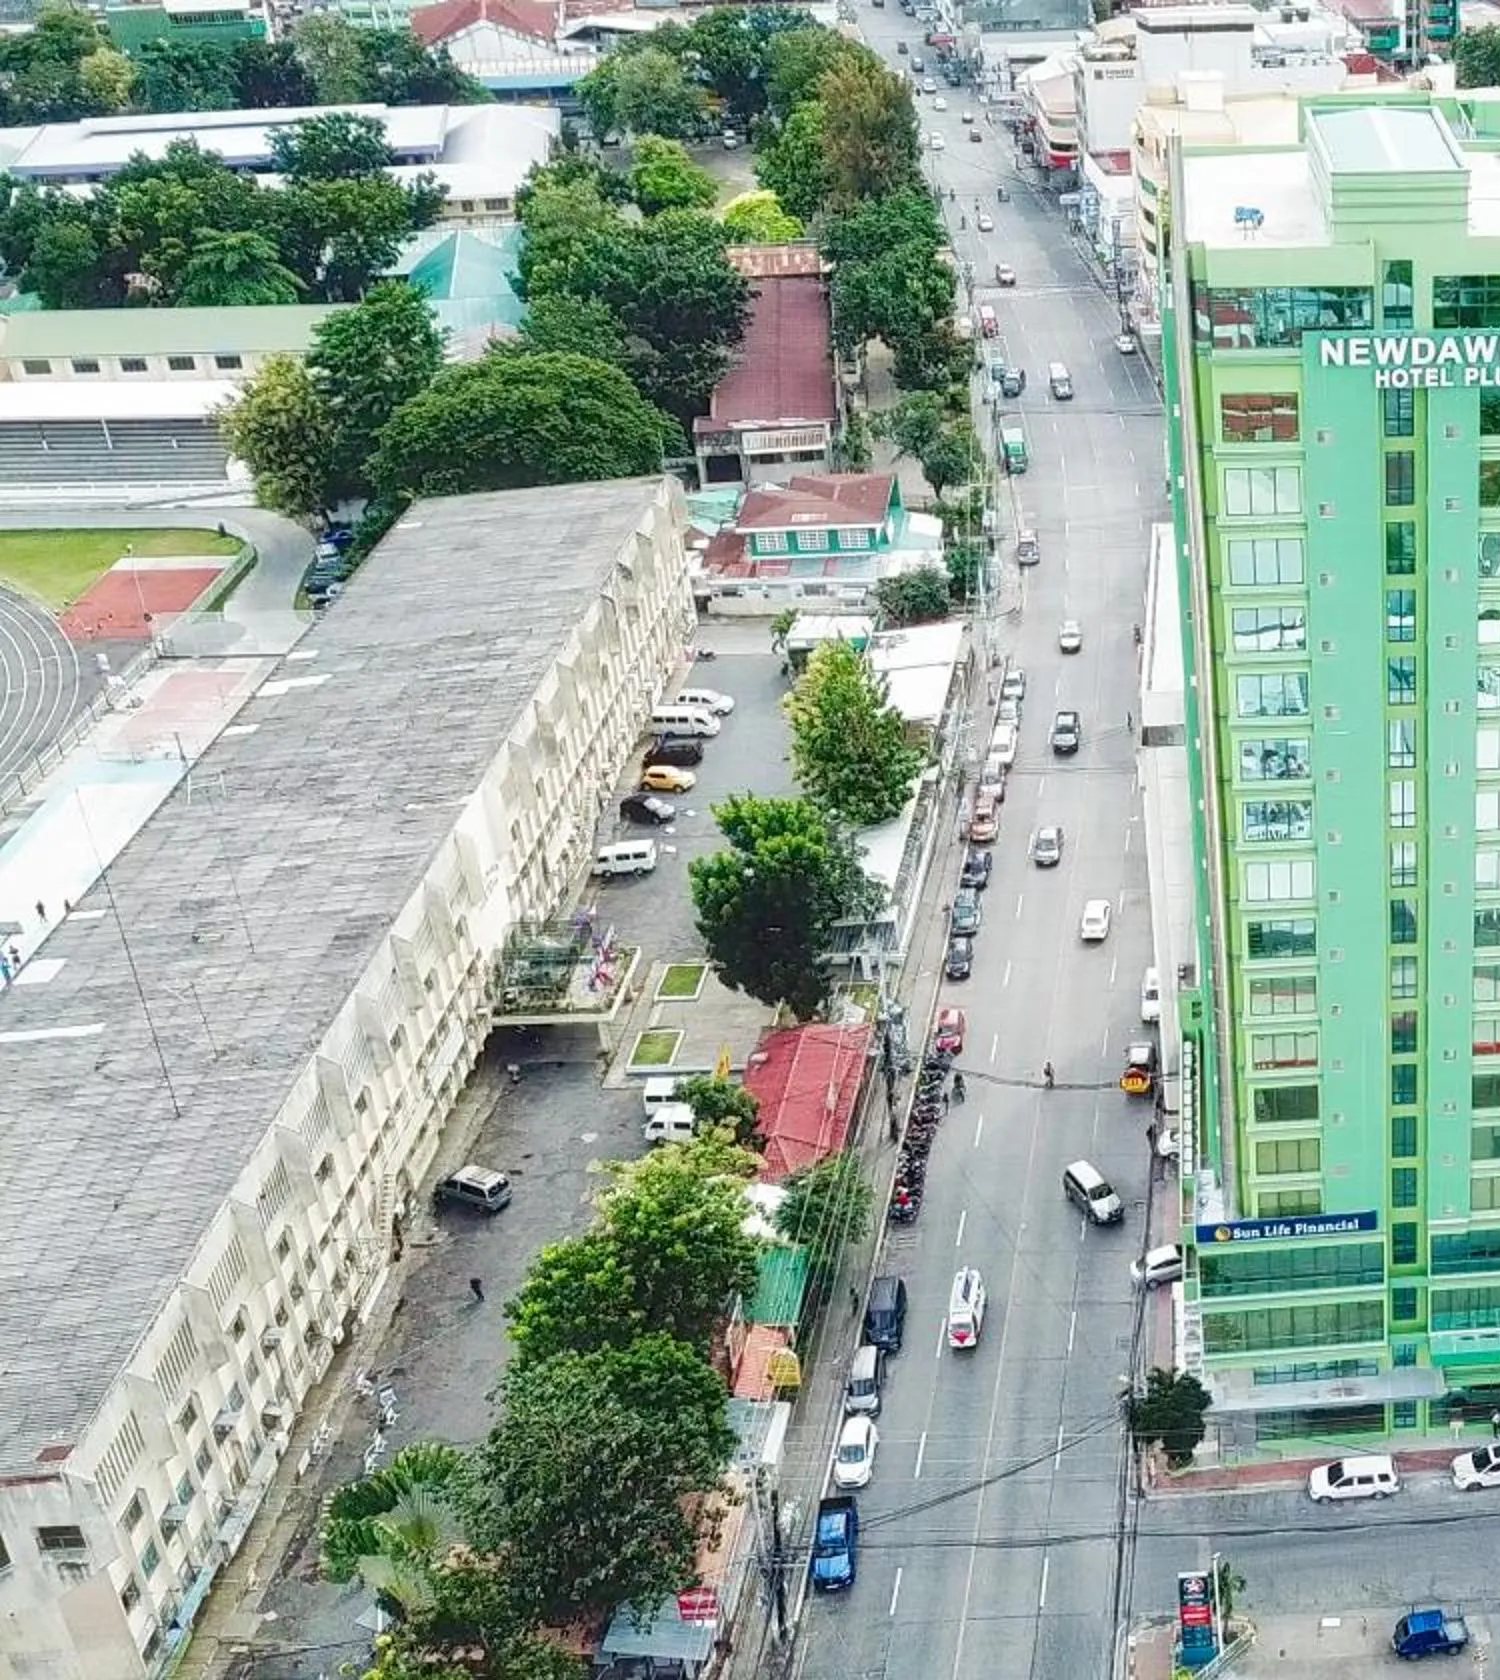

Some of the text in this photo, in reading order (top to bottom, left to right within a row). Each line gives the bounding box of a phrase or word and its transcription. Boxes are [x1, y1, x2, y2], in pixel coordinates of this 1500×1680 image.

[1375, 367, 1455, 388] HOTEL
[1233, 1218, 1359, 1239] Sun Life Financial
